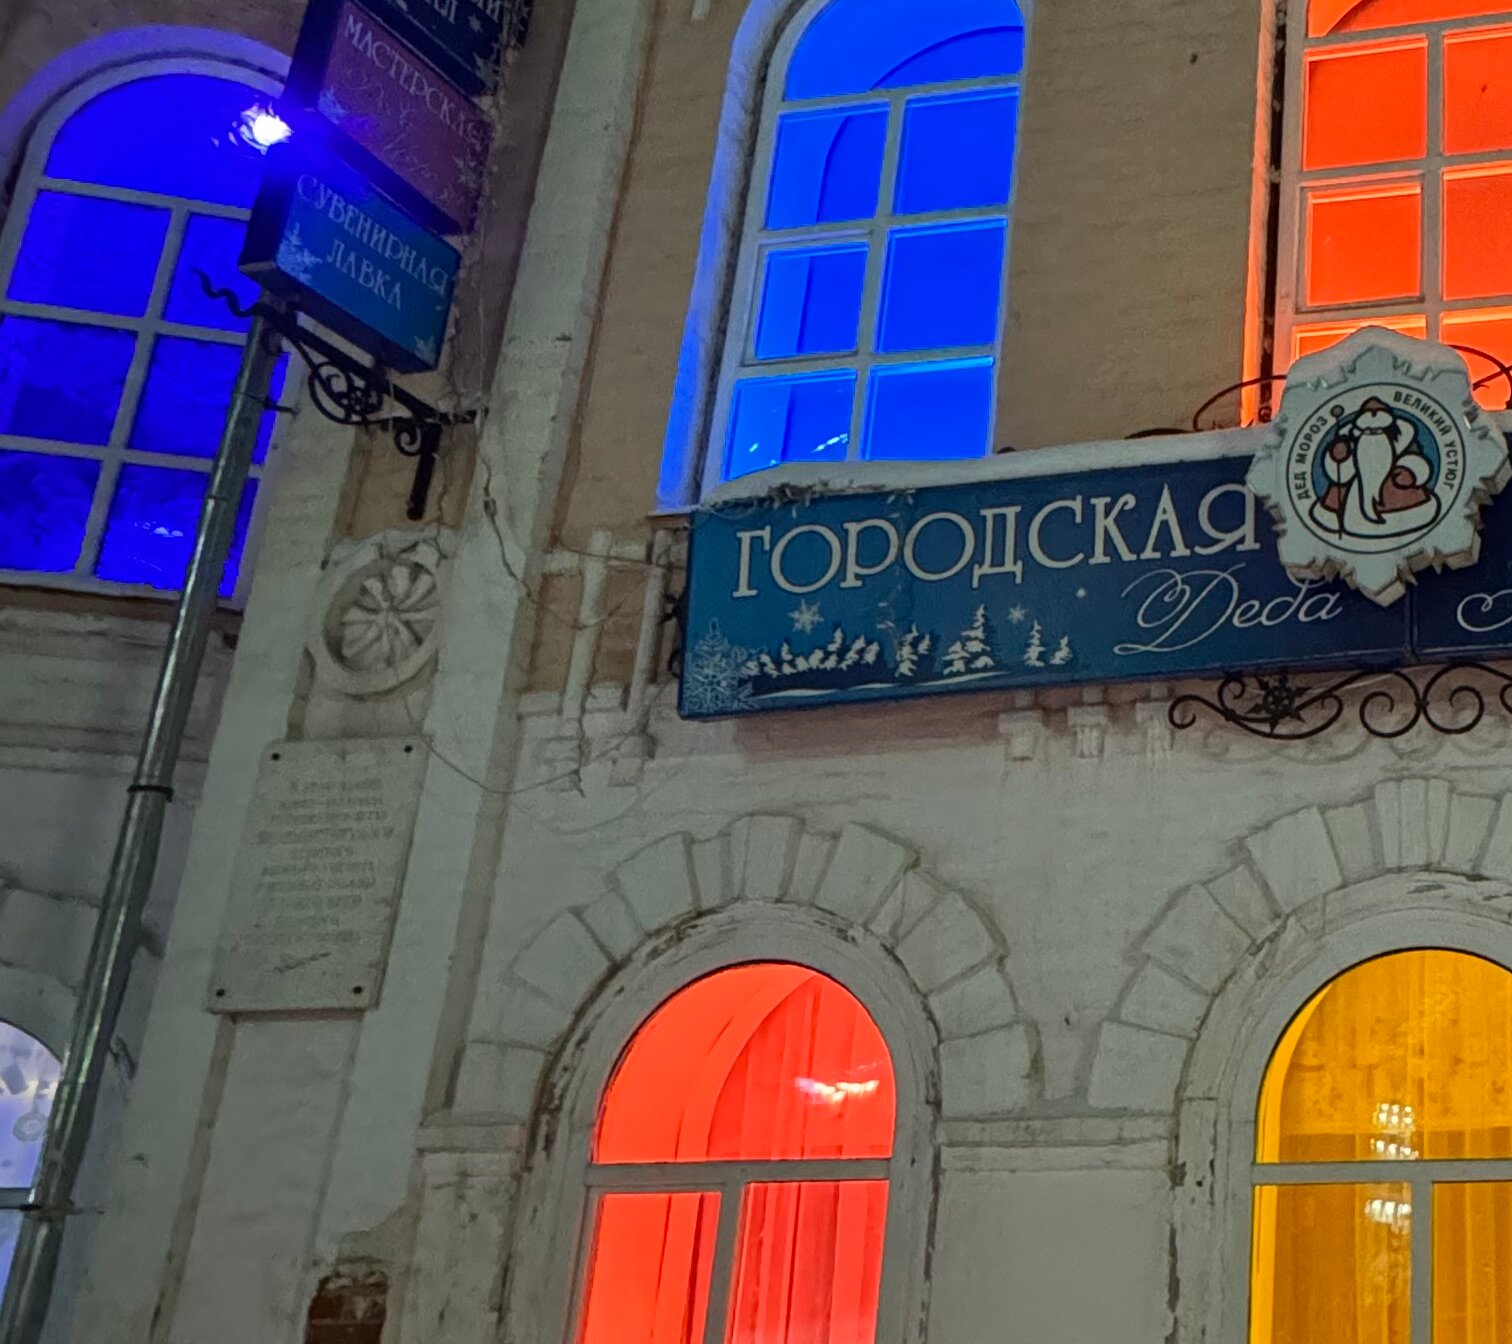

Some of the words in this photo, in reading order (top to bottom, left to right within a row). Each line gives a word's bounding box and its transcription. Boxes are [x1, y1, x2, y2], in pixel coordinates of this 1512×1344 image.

[344, 13, 485, 146] МАСТЕРСКАЯ
[296, 174, 449, 299] СУВЕНИРНАЯ
[326, 239, 401, 311] ЛАВКА
[1294, 471, 1311, 500] ДЕД
[1296, 416, 1328, 464] МОРОЗ
[1393, 391, 1451, 437] ВЕЛИКИЙ
[1443, 439, 1458, 490] УСТЮГ
[732, 483, 1260, 599] ГОРОДСКАЯ
[1113, 562, 1343, 654] Деда
